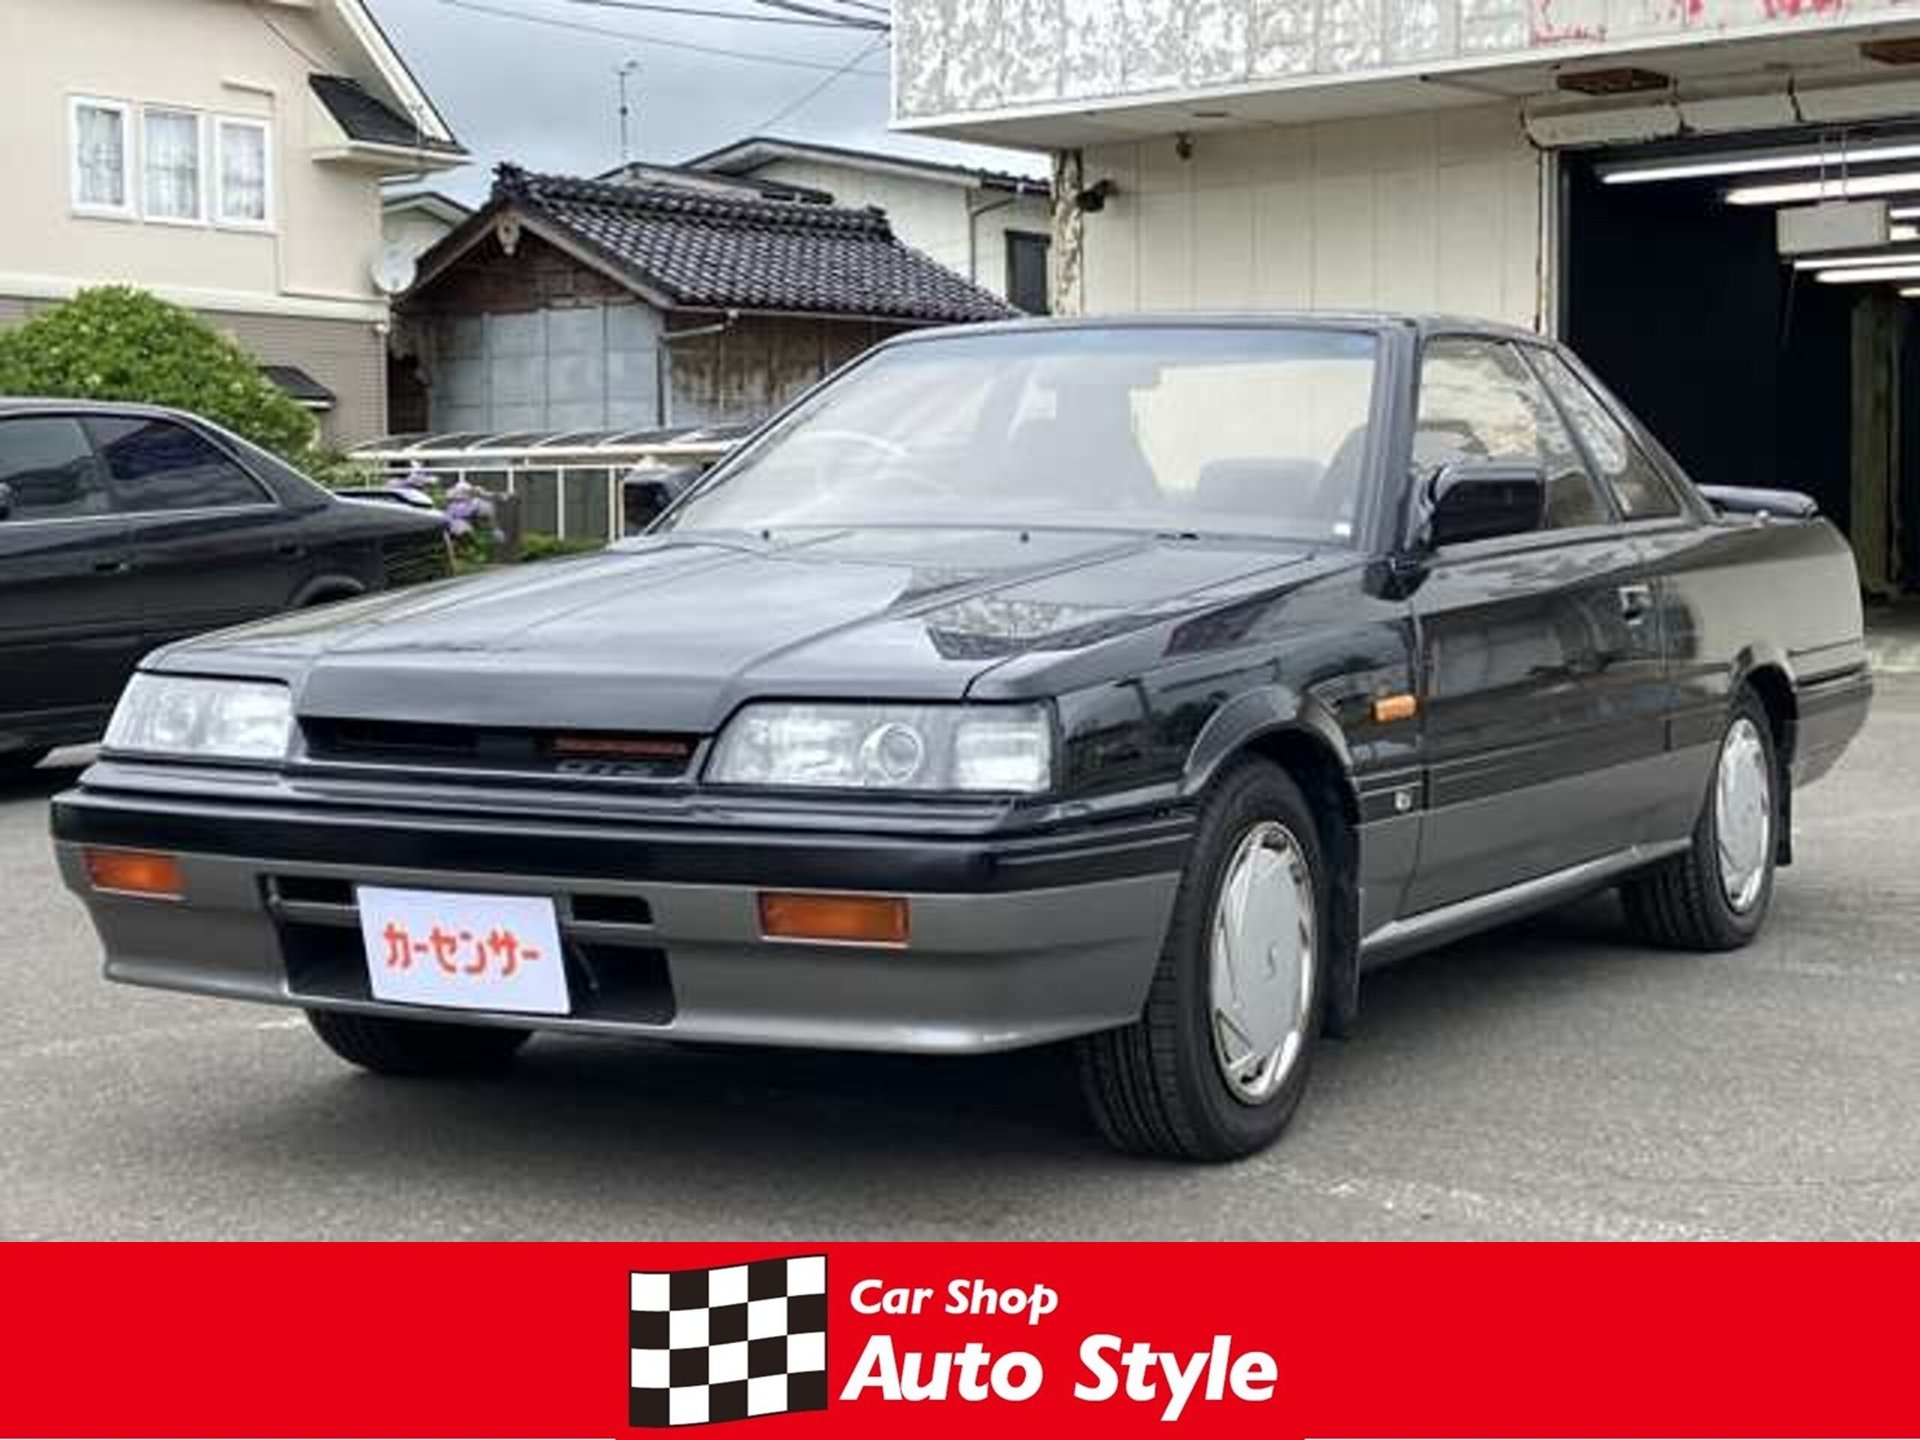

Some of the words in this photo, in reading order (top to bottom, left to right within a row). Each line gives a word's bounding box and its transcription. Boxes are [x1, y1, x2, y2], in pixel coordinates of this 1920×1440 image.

[383, 922, 540, 977] カーセンサー
